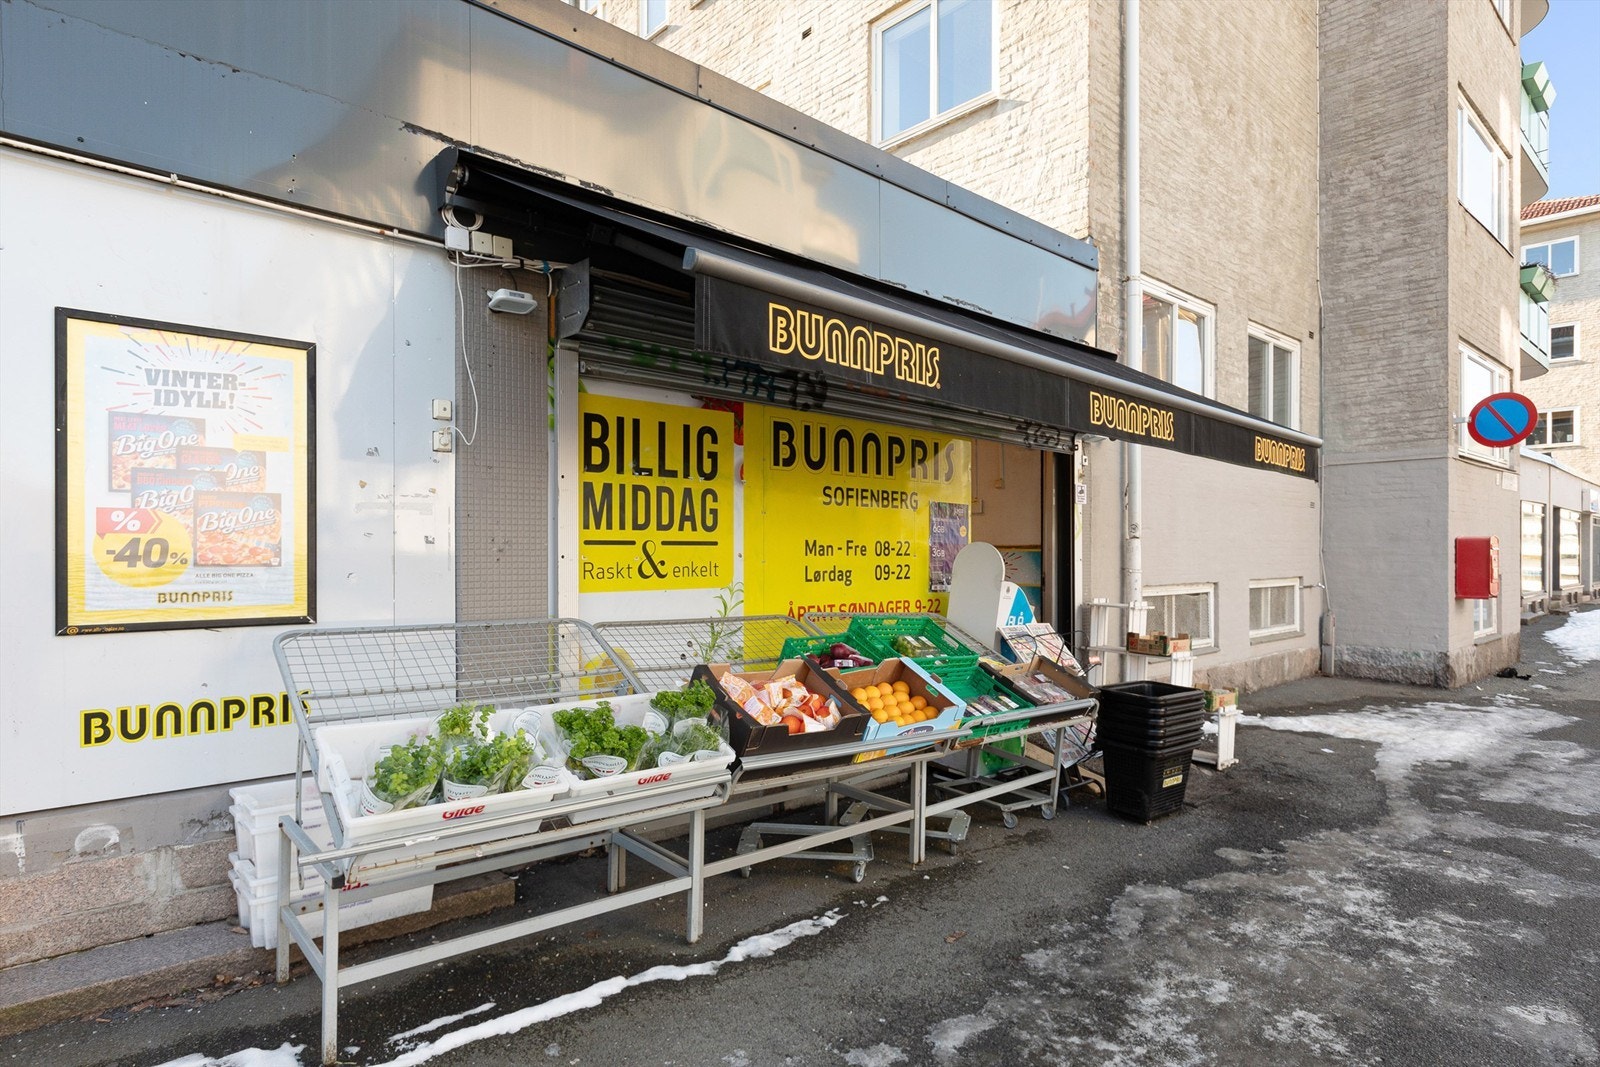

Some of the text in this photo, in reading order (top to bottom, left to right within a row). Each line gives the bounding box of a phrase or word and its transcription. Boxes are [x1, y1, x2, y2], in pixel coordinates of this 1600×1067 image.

[767, 302, 941, 390] BUNNPRIS
[145, 366, 247, 392] VINTER-
[153, 388, 236, 410] IDYLL!
[1088, 390, 1176, 442] BUNNPRIS
[583, 411, 719, 482] BILLIG
[771, 419, 956, 484] BUNNPRIS
[1253, 434, 1307, 473] BUNNPRIS
[582, 480, 719, 533] MIDDAG
[822, 485, 920, 511] SOFIENBERG
[583, 539, 720, 580] Raskt & enkelt
[804, 539, 834, 557] Man
[846, 540, 867, 557] Fre
[874, 540, 911, 557] 08-22
[804, 563, 911, 586] Lørdag 09-22
[157, 590, 234, 605] BUNNPRIS
[915, 598, 942, 613] 9-22
